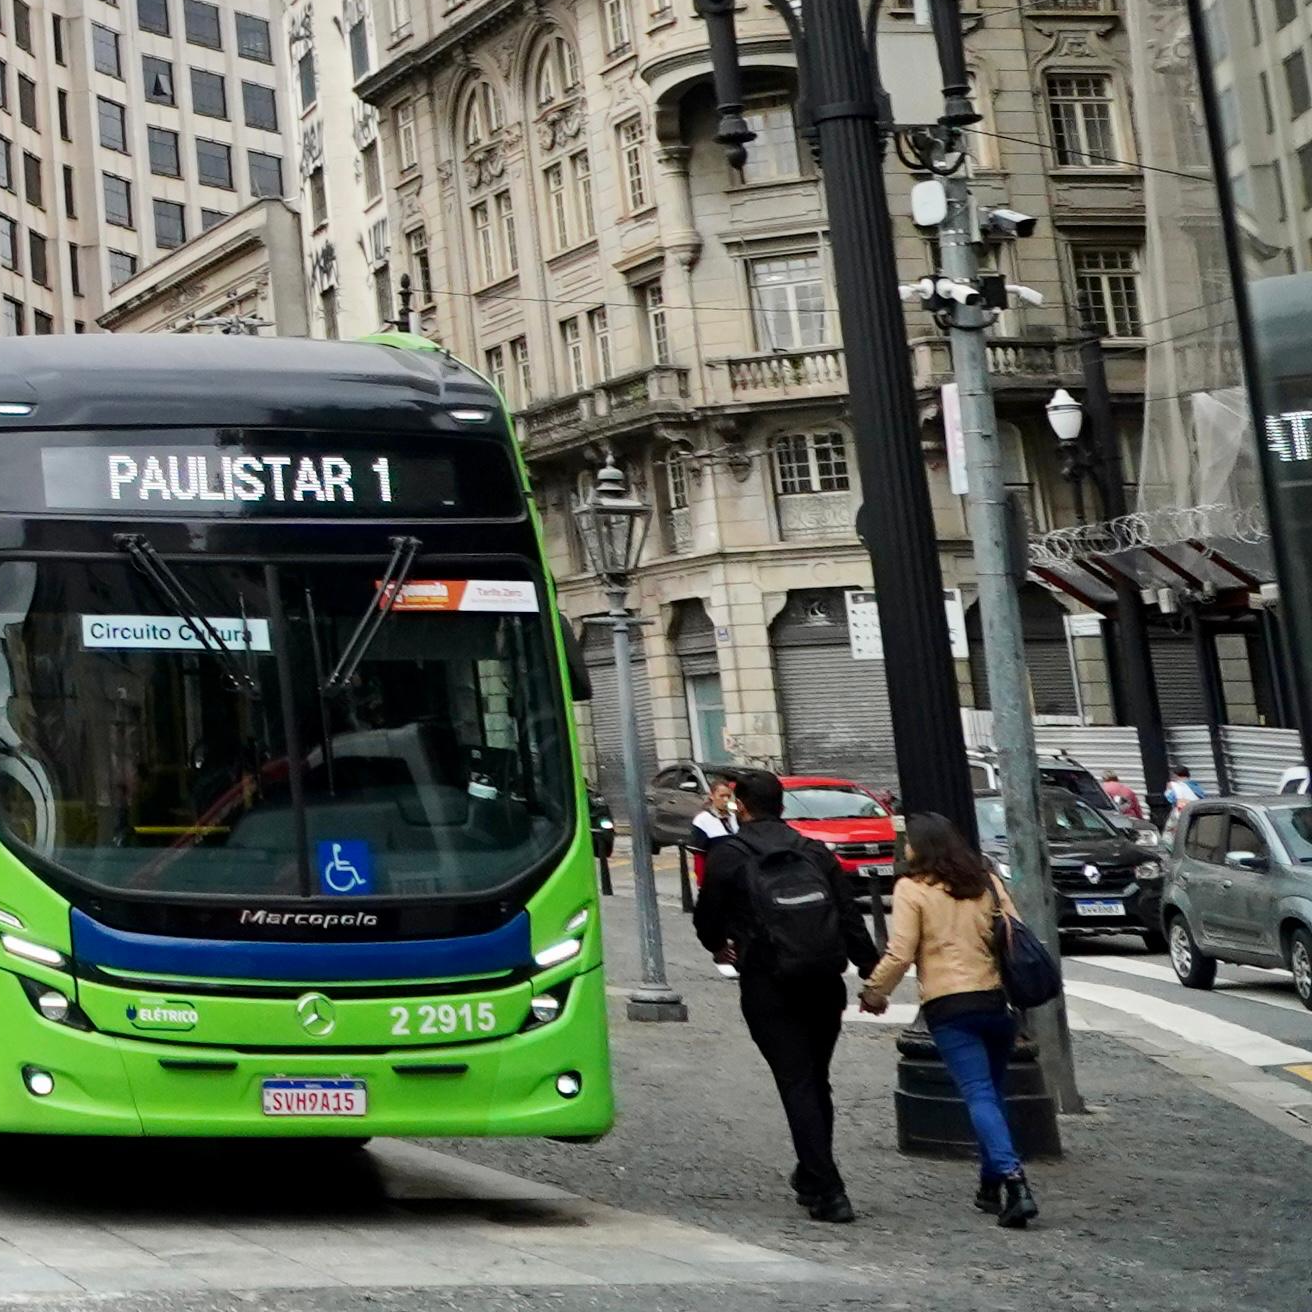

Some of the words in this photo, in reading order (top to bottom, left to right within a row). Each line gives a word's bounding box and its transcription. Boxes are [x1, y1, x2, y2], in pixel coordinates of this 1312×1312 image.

[108, 455, 354, 502] PAULISTAR
[372, 457, 392, 502] 1
[89, 622, 172, 642] Circuito
[240, 909, 378, 929] Marcopolo
[138, 1006, 199, 1025] ELÉTRICO
[389, 1006, 411, 1036] 2
[418, 1003, 497, 1035] 2915
[271, 1090, 355, 1112] SVH9A15
